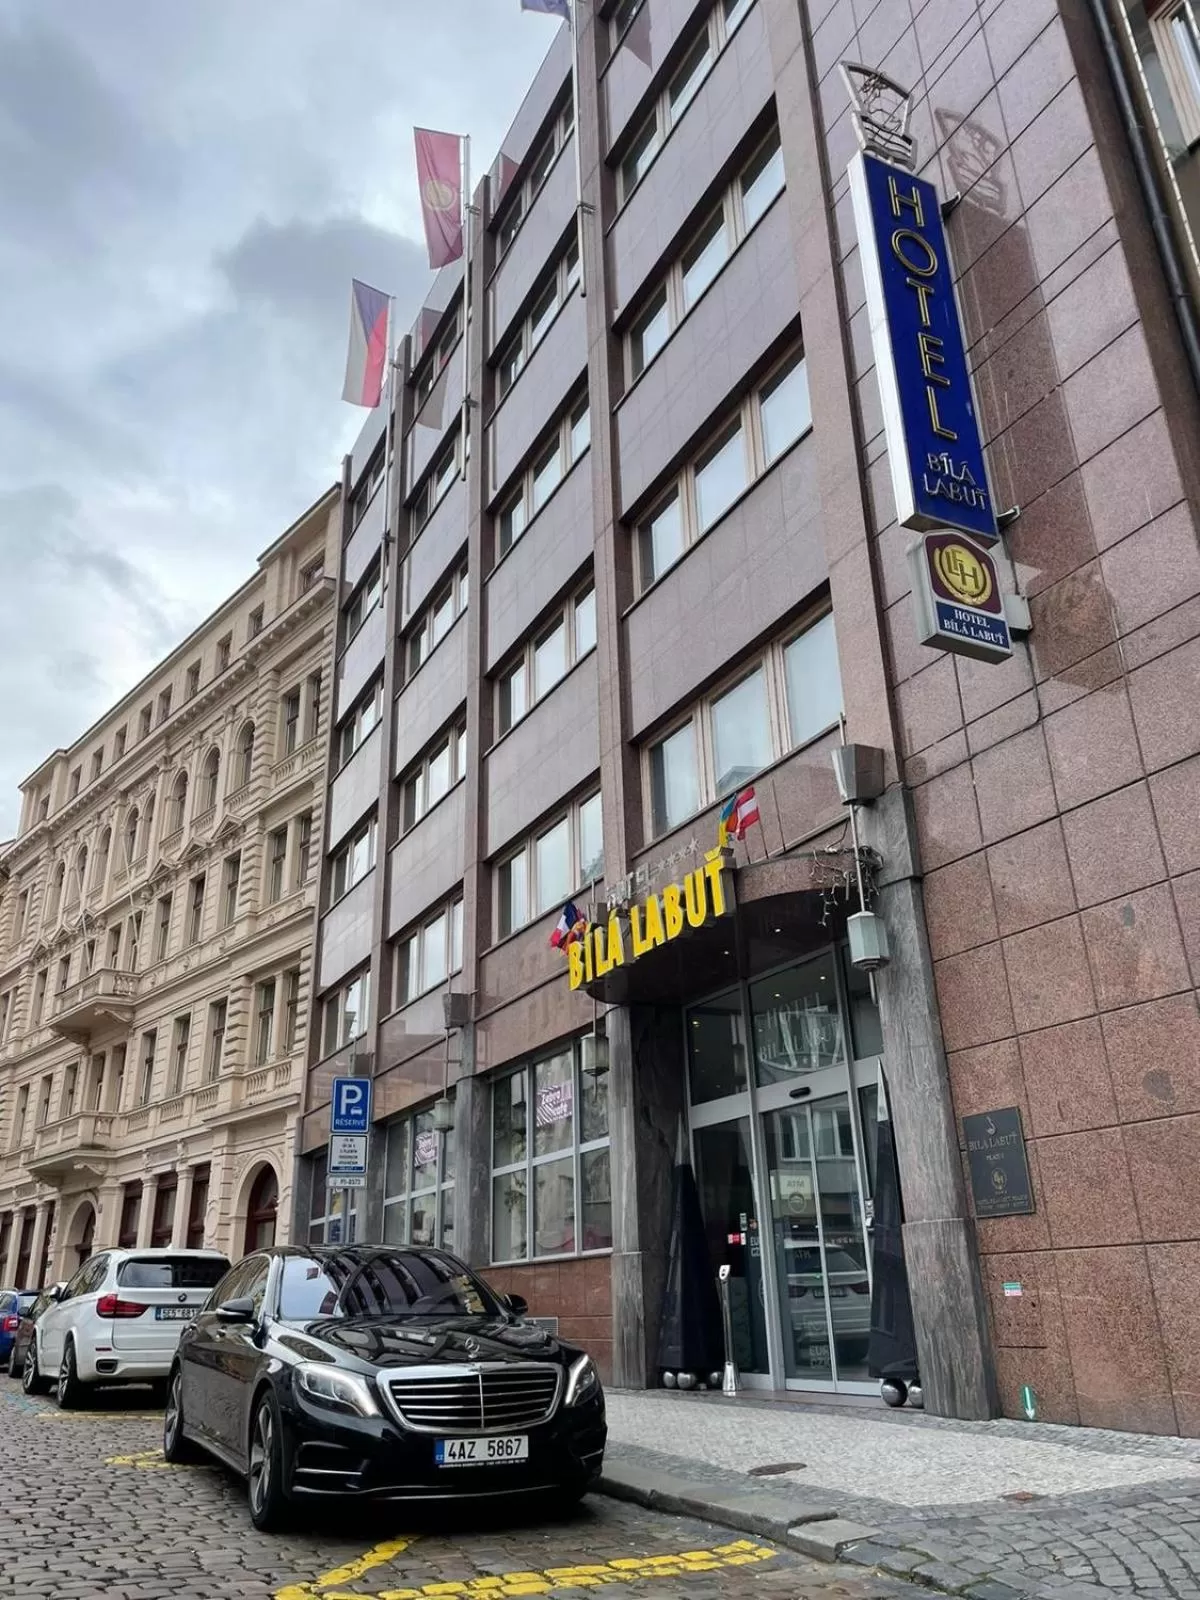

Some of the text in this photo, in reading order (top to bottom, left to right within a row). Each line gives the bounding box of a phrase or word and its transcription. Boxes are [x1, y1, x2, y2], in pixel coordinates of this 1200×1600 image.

[888, 175, 958, 440] HOTEL
[943, 619, 1004, 645] BÍLÁ LABUŤ
[954, 608, 990, 628] HOTEL
[568, 844, 725, 991] BÍLÁ LABUŤ
[340, 1084, 362, 1115] P
[448, 1438, 522, 1460] 4AZ 5867
